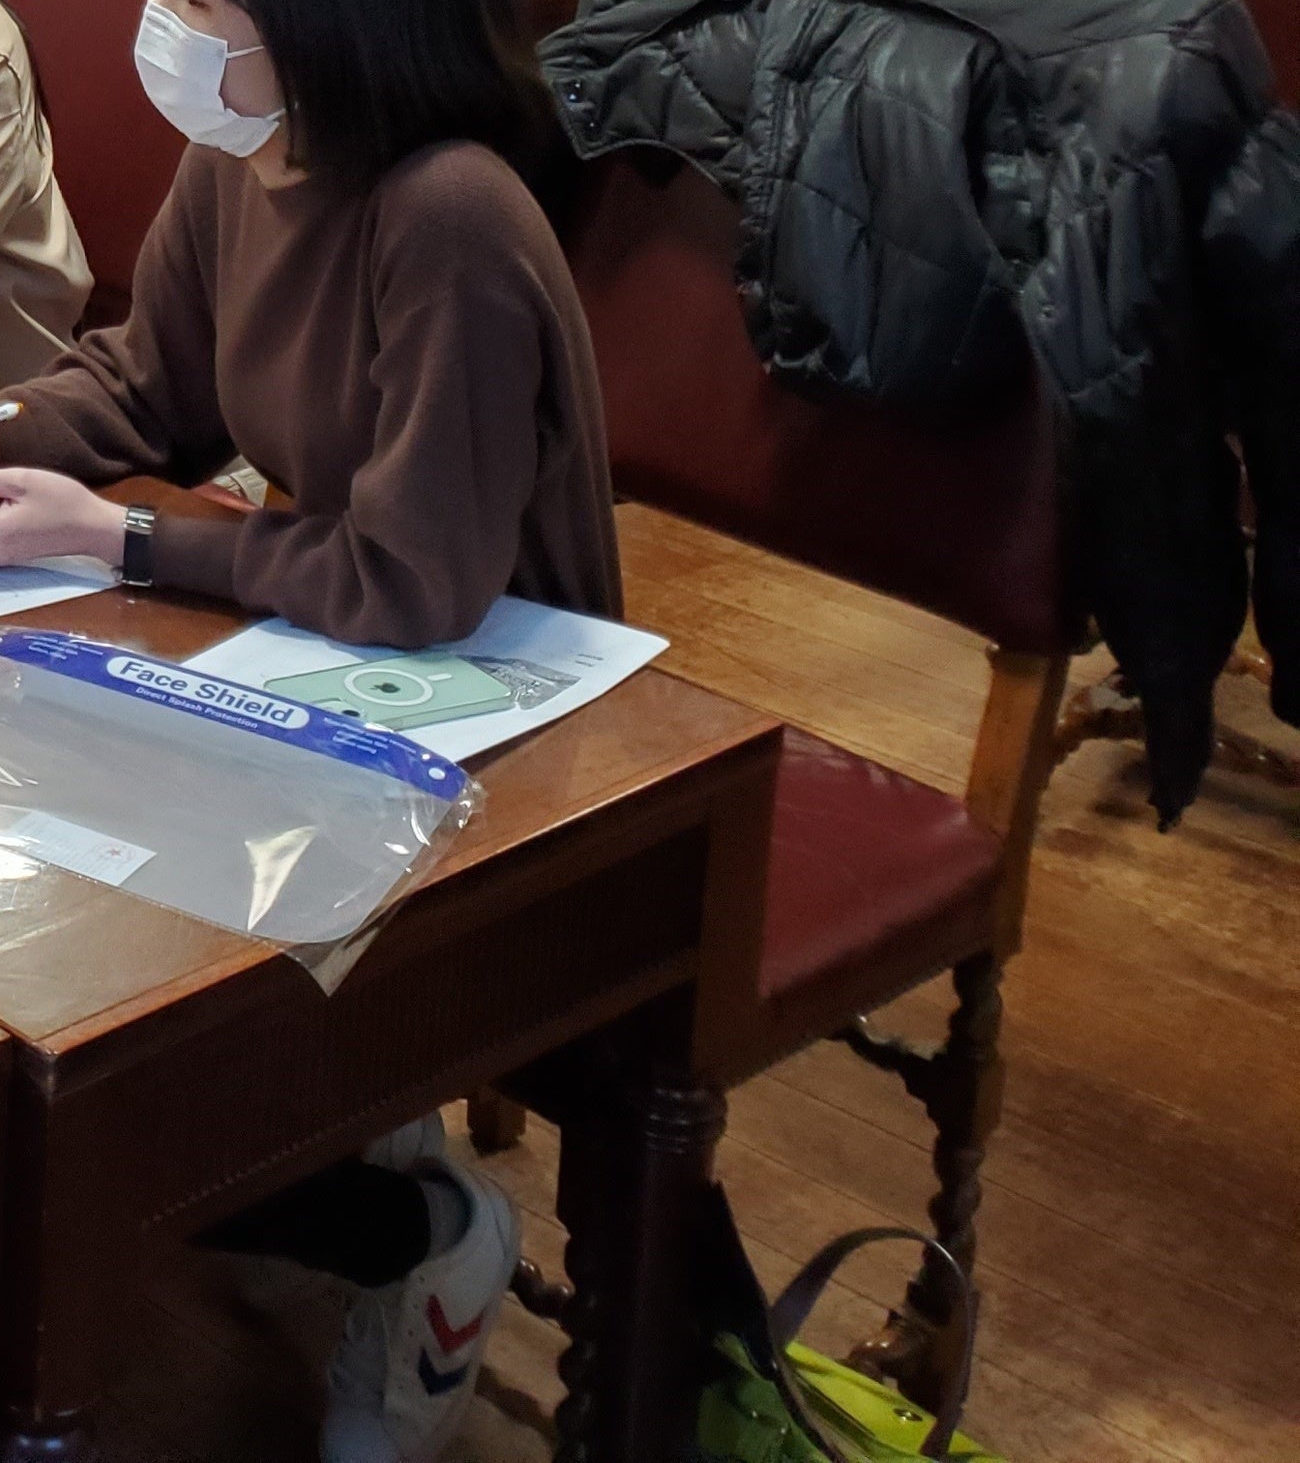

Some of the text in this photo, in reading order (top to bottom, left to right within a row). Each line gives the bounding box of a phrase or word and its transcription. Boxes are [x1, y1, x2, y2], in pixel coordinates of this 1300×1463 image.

[119, 660, 294, 724] Face Shield
[136, 686, 258, 730] Direct Splash Protection
